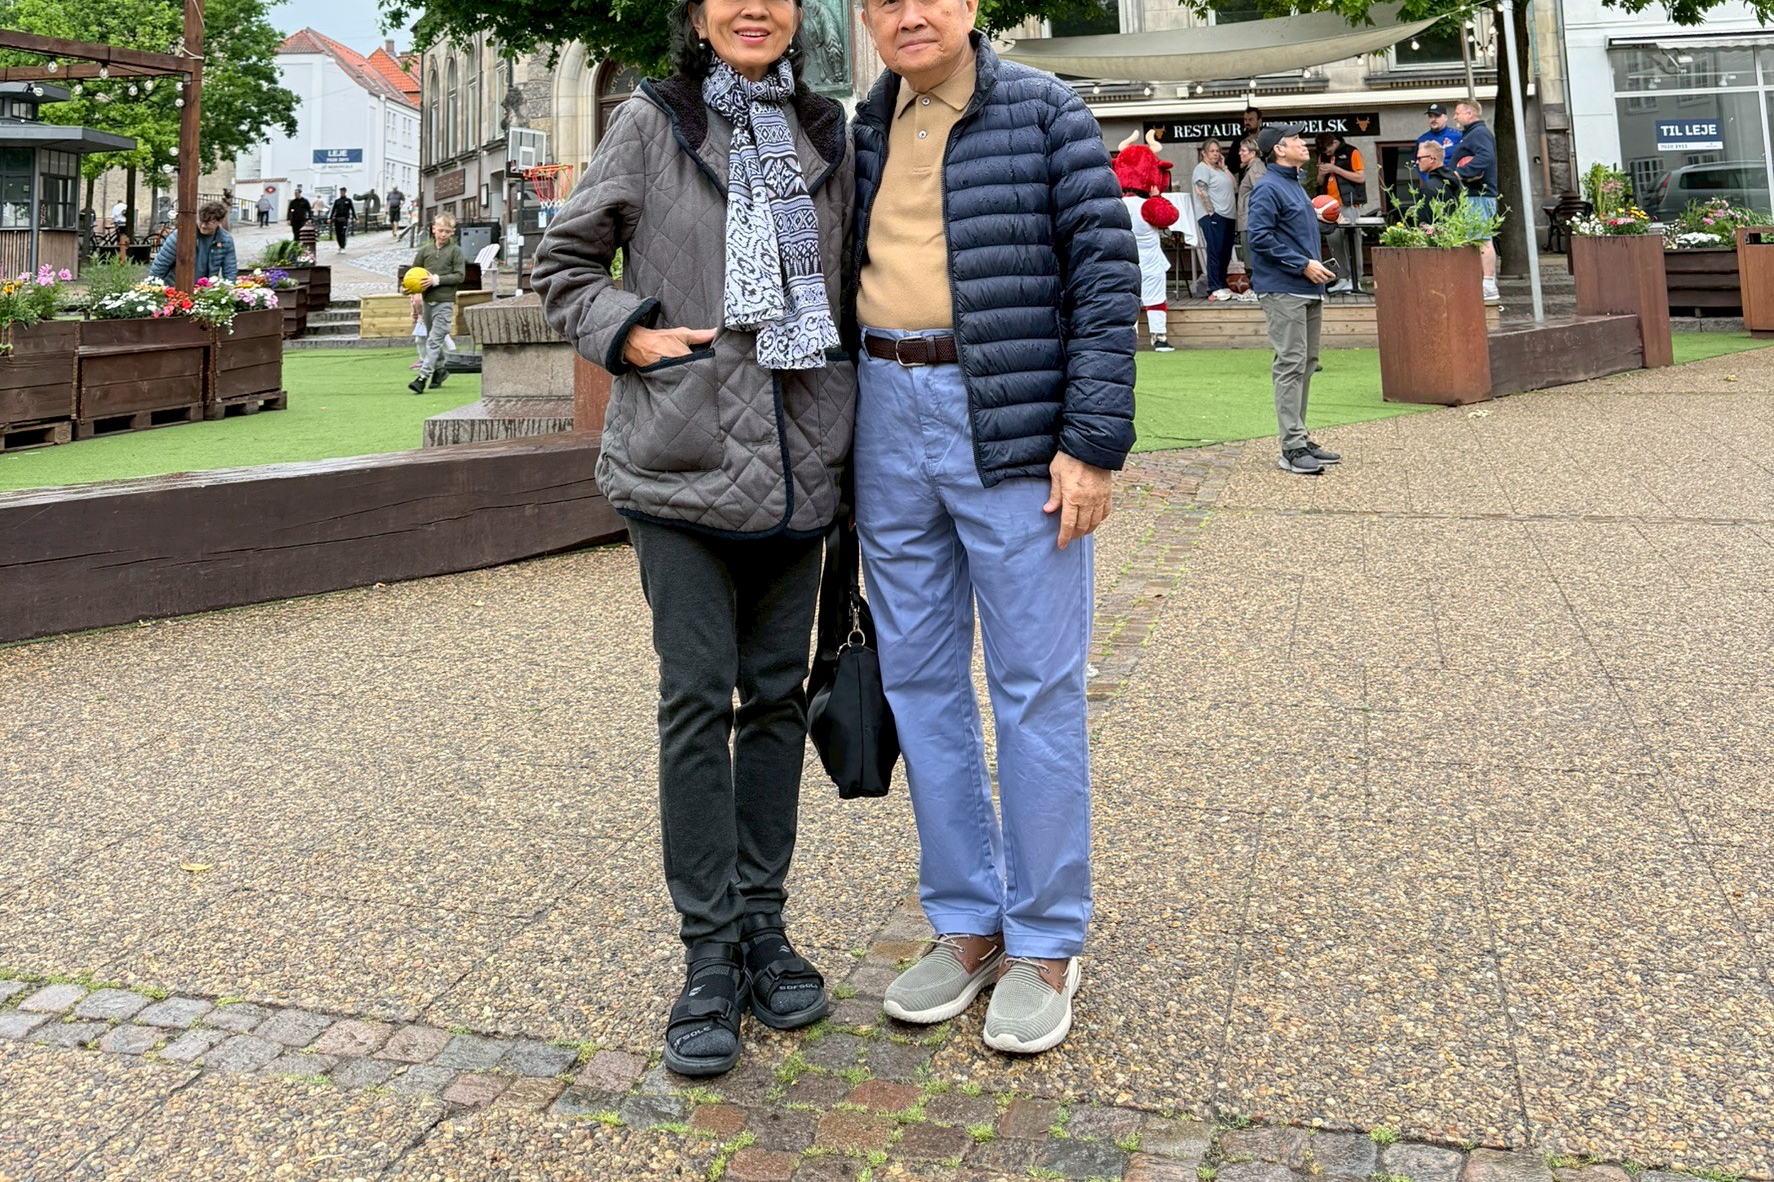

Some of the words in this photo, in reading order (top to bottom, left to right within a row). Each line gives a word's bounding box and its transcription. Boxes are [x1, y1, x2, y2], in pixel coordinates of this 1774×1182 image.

[1173, 121, 1272, 138] RESTAURT
[1276, 119, 1348, 134] BELSK
[1660, 125, 1683, 136] TIL
[1685, 124, 1717, 136] LEJE
